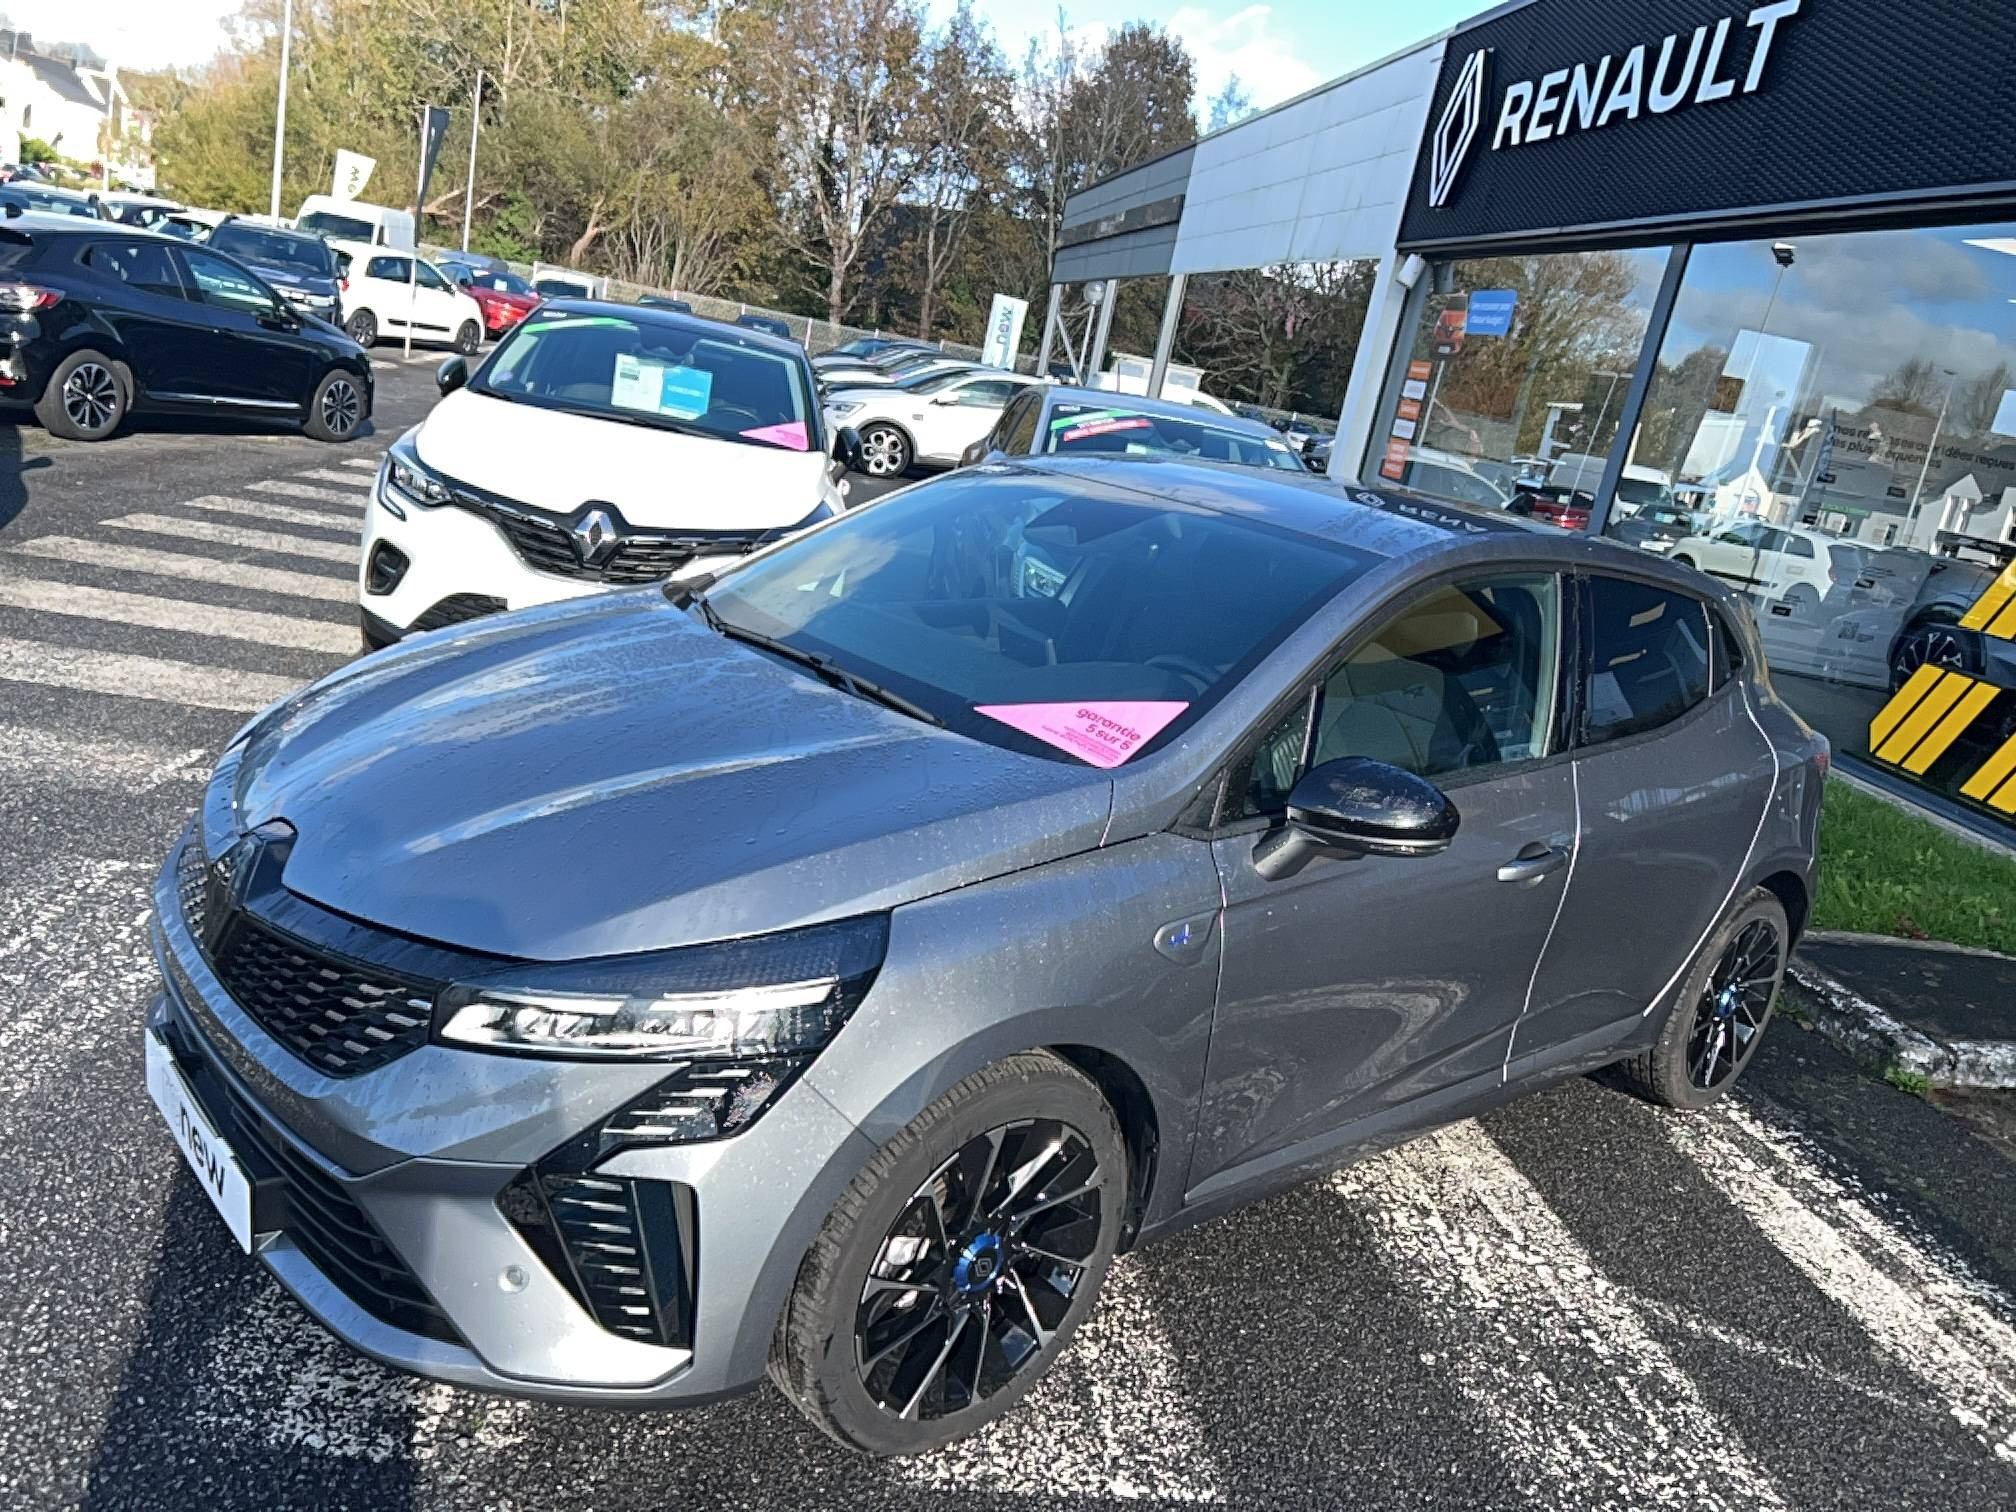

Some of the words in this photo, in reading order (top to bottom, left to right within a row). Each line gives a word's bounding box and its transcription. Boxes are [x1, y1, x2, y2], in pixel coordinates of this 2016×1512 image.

[1492, 0, 1800, 151] RENAULT
[1857, 429, 1914, 449] rénses
[1076, 708, 1140, 740] garantie
[1086, 723, 1096, 734] 5
[1095, 729, 1121, 745] sur
[1119, 738, 1132, 751] 5
[179, 1101, 226, 1198] new
